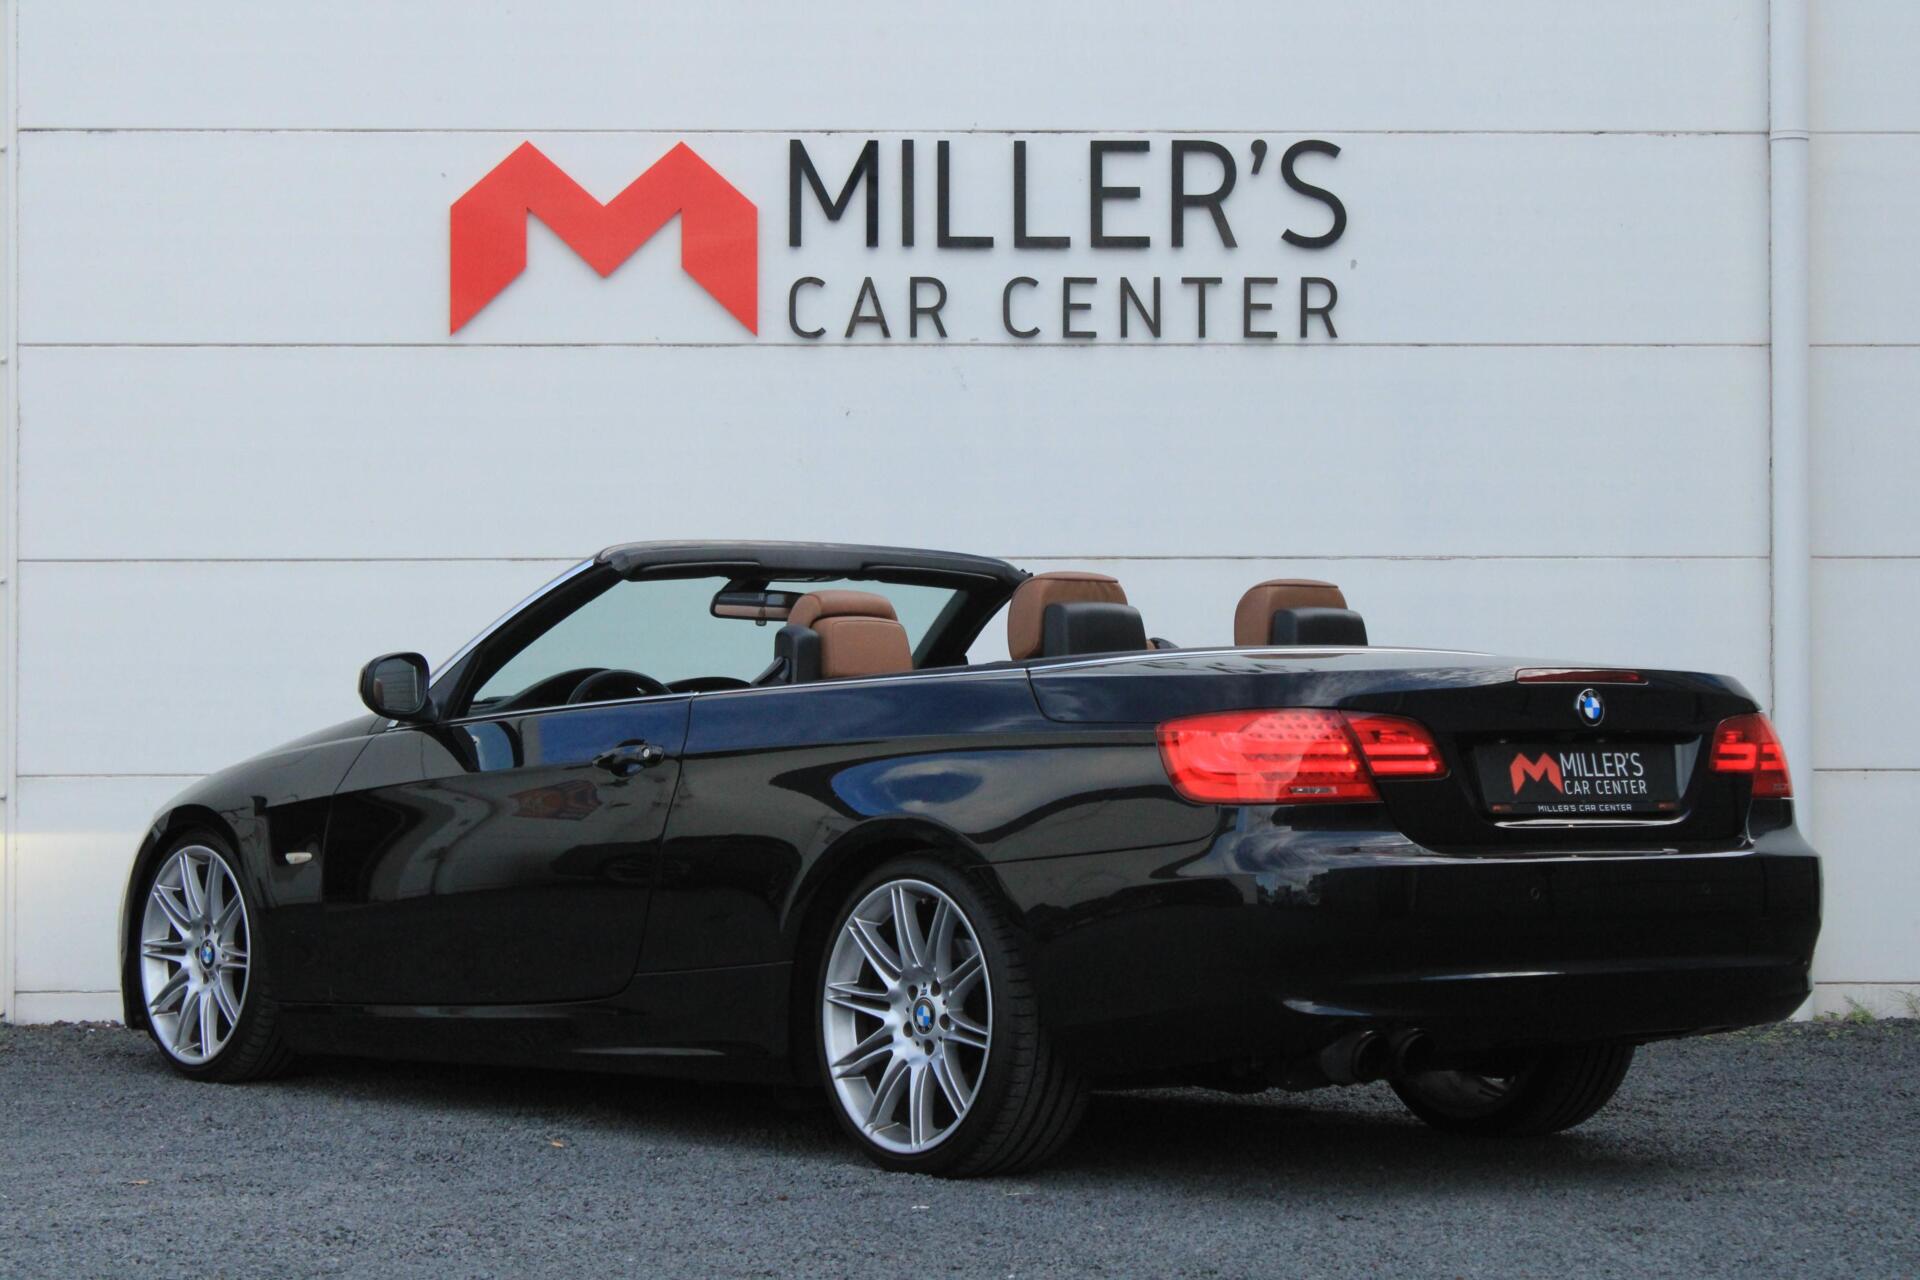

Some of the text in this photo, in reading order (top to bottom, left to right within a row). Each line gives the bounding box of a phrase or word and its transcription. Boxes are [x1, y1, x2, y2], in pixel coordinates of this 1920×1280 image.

[789, 139, 1347, 250] MILLER'S
[789, 276, 1339, 341] CAR CENTER
[1560, 752, 1644, 777] MILLER'S
[1564, 779, 1647, 795] CAR CENTER
[1579, 804, 1597, 812] CAR
[1599, 803, 1632, 812] CENTER
